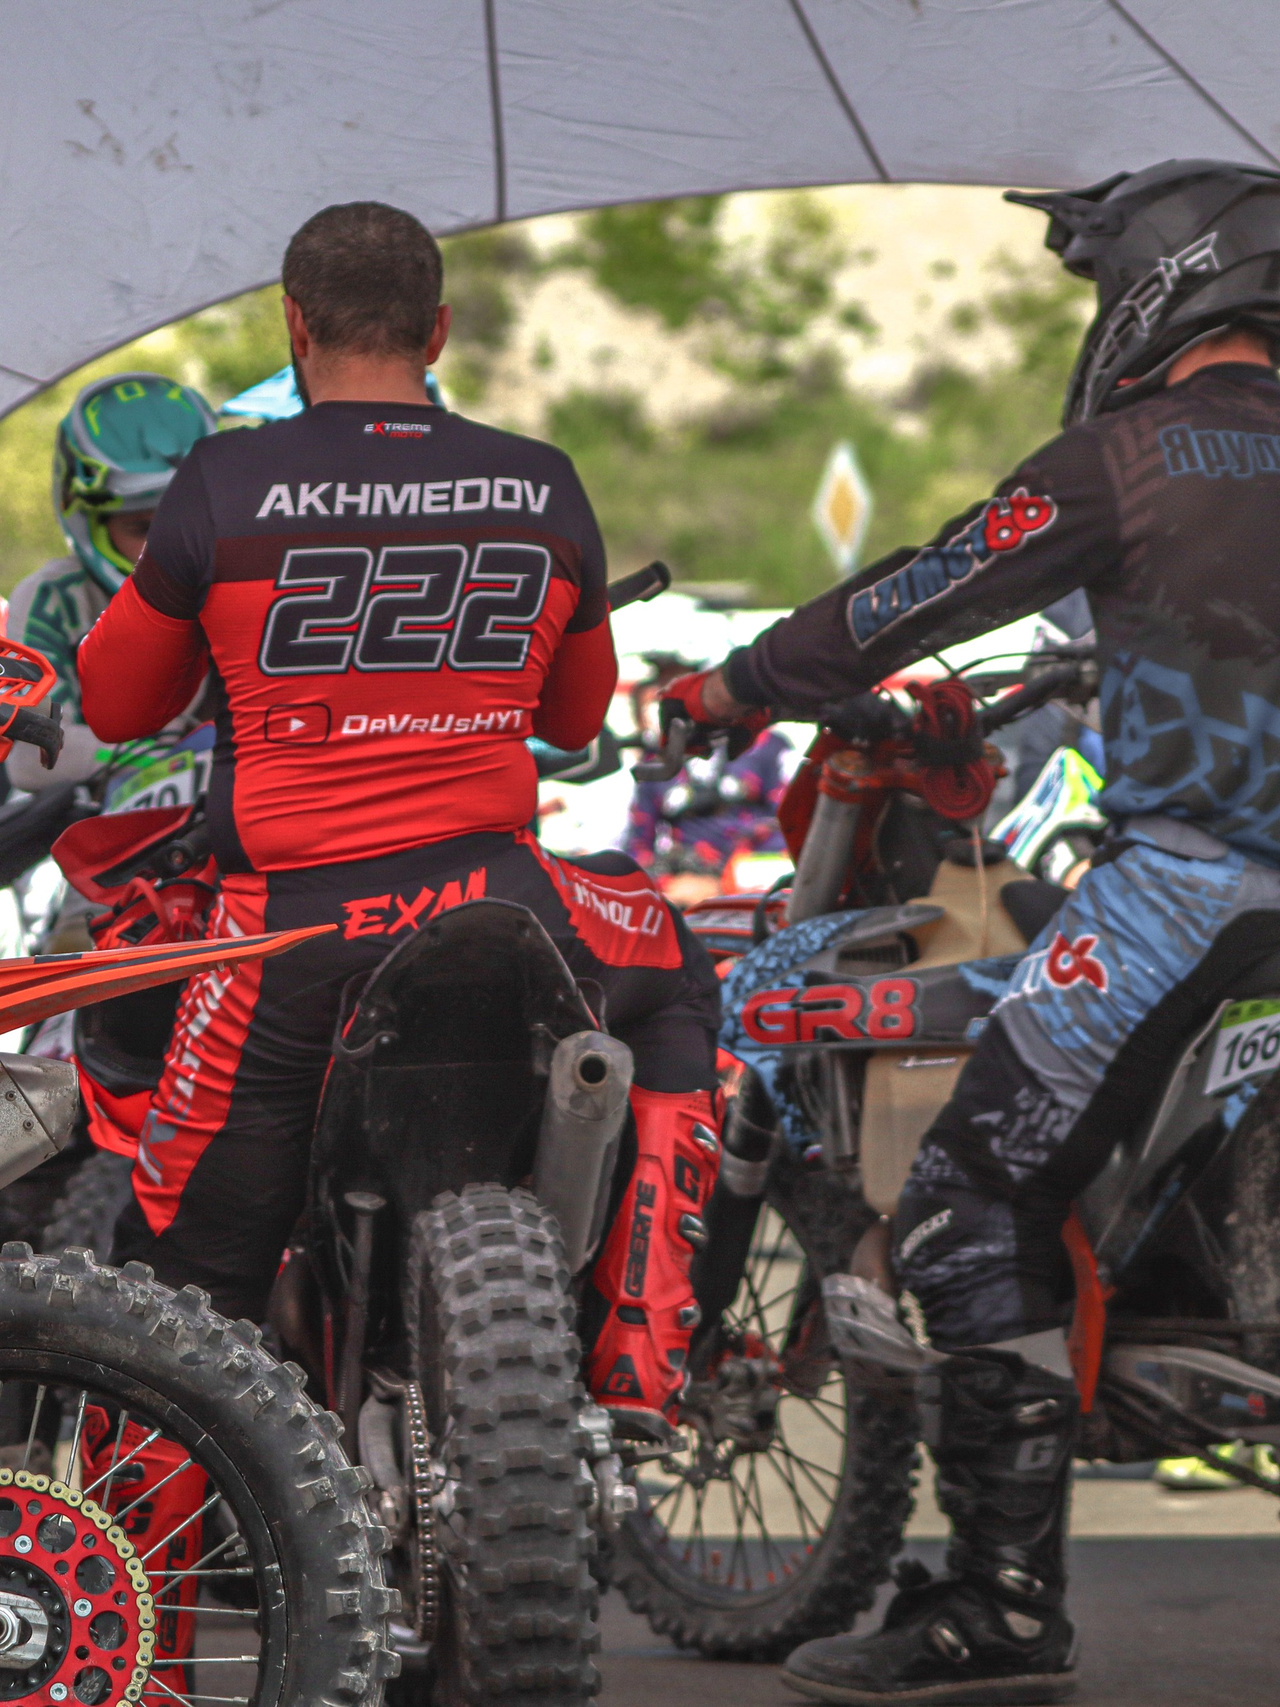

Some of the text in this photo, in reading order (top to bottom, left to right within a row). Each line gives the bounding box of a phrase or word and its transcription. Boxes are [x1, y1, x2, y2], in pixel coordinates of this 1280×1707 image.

[255, 476, 551, 518] AKHMEDOV
[257, 541, 553, 677] 222
[741, 977, 917, 1044] GR8
